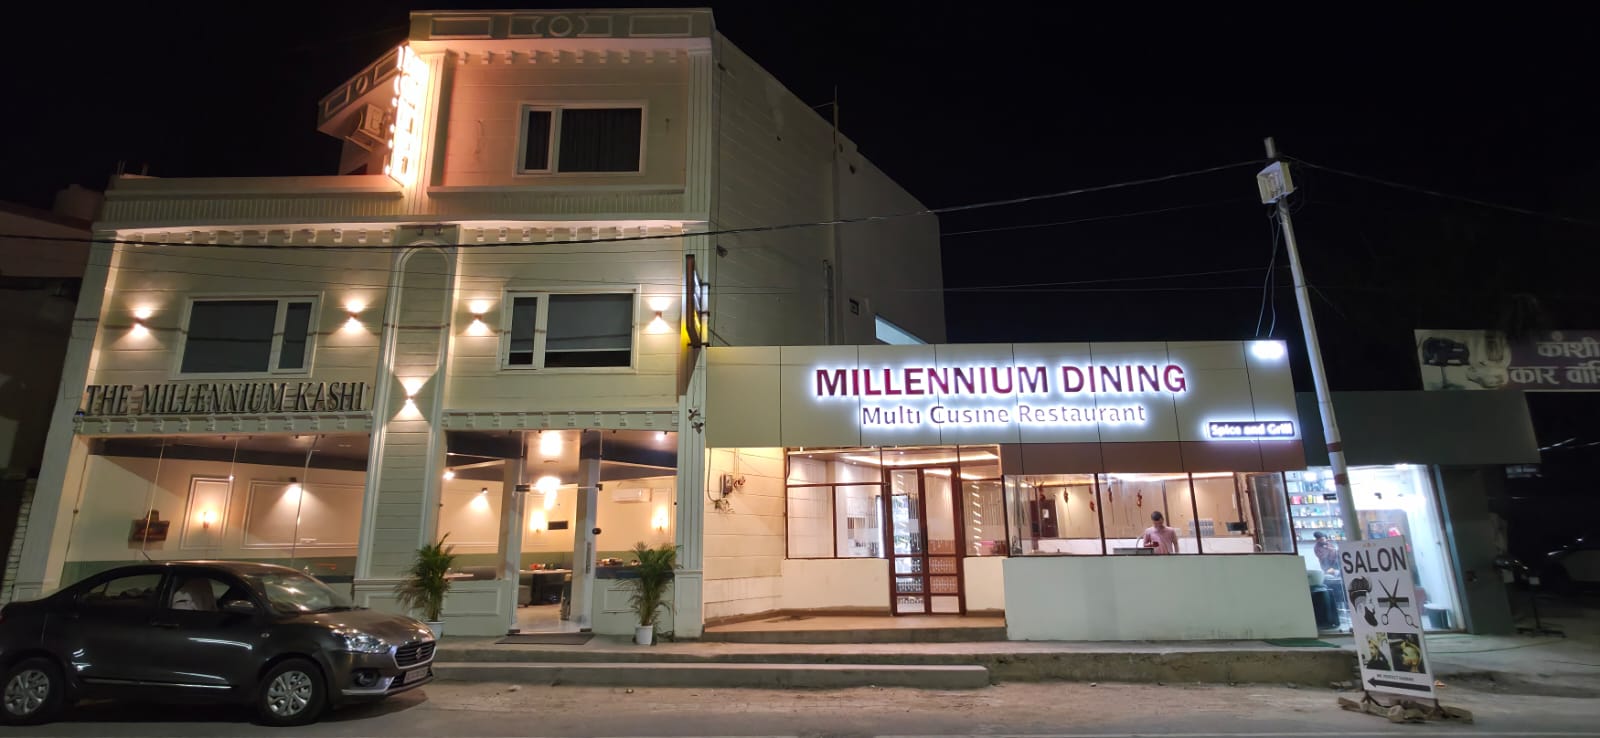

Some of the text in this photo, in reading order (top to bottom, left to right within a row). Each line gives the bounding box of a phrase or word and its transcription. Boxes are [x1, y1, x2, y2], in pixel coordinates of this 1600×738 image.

[816, 364, 1187, 396] MILLENNIUM DINING
[1509, 366, 1560, 384] कार
[85, 381, 367, 415] THE MILLENNIUM KASHI
[862, 404, 1146, 425] Multi Cusine Restaurant
[1211, 423, 1293, 437] Spice and Grill
[1341, 546, 1407, 574] SALON
